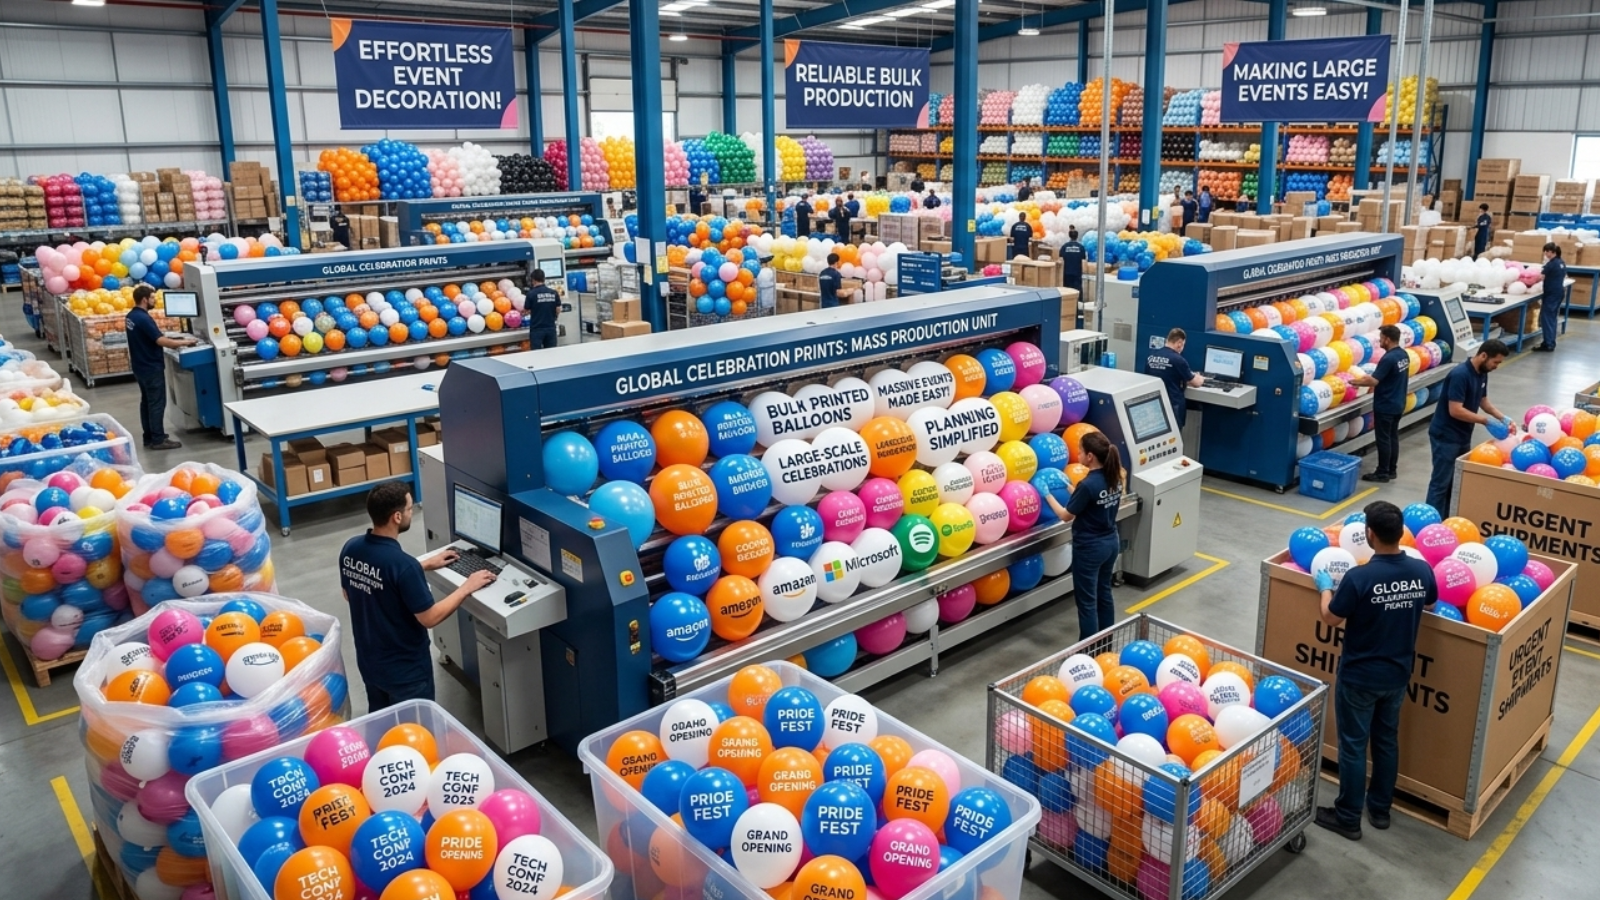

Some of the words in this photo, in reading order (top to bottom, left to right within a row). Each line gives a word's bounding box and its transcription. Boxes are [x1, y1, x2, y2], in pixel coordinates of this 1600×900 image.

[359, 40, 492, 64] EFFORTLESS
[394, 66, 463, 86] EVENT
[795, 63, 876, 85] RELIABLE
[880, 67, 922, 86] BULK
[1234, 61, 1307, 81] MAKING
[1313, 58, 1377, 78] LARGE
[355, 89, 502, 109] DECORATION!
[804, 87, 913, 108] PRODUCTION
[1239, 83, 1308, 102] EVENTS
[1313, 82, 1369, 100] EASY!
[615, 368, 683, 395] GLOBAL
[686, 349, 790, 382] CELEBRATION
[794, 340, 848, 363] PRINTS:
[851, 331, 887, 353] MASS
[891, 318, 969, 345] PRODUCTION
[971, 313, 998, 330] UNIT
[766, 400, 807, 419] BULK
[809, 388, 869, 410] PRINTED
[888, 392, 920, 408] MADE
[772, 407, 852, 435] BALLOONS
[925, 406, 995, 434] PLANNING
[930, 422, 999, 450] SIMPLIFIED
[778, 441, 863, 469] LARGE-SCALE
[1496, 502, 1593, 538] URGENT
[343, 556, 382, 581] GLOBAL
[1373, 579, 1424, 595] GLOBAL
[831, 708, 866, 722] PRIDE
[780, 720, 813, 732] FEST
[831, 720, 862, 734] FEST
[378, 759, 414, 775] TECH
[834, 764, 873, 777] PRIDE
[380, 770, 416, 787] CONF
[446, 772, 480, 783] TECH
[384, 782, 416, 798] 2024
[896, 785, 934, 801] PRIDE
[694, 805, 732, 821] FEST
[818, 806, 863, 820] PRIDE
[896, 797, 930, 812] FEST
[746, 830, 788, 841] GRAND
[820, 821, 860, 835] FEST
[954, 816, 989, 839] FEST
[370, 827, 408, 849] TECH
[441, 837, 483, 848] PRIDE
[742, 842, 792, 852] OPENING
[890, 840, 930, 856] GRAND
[513, 853, 548, 872] TECH
[298, 866, 338, 888] TECH
[507, 865, 545, 884] CONF
[506, 878, 538, 896] 2024
[810, 883, 855, 900] GRAND
